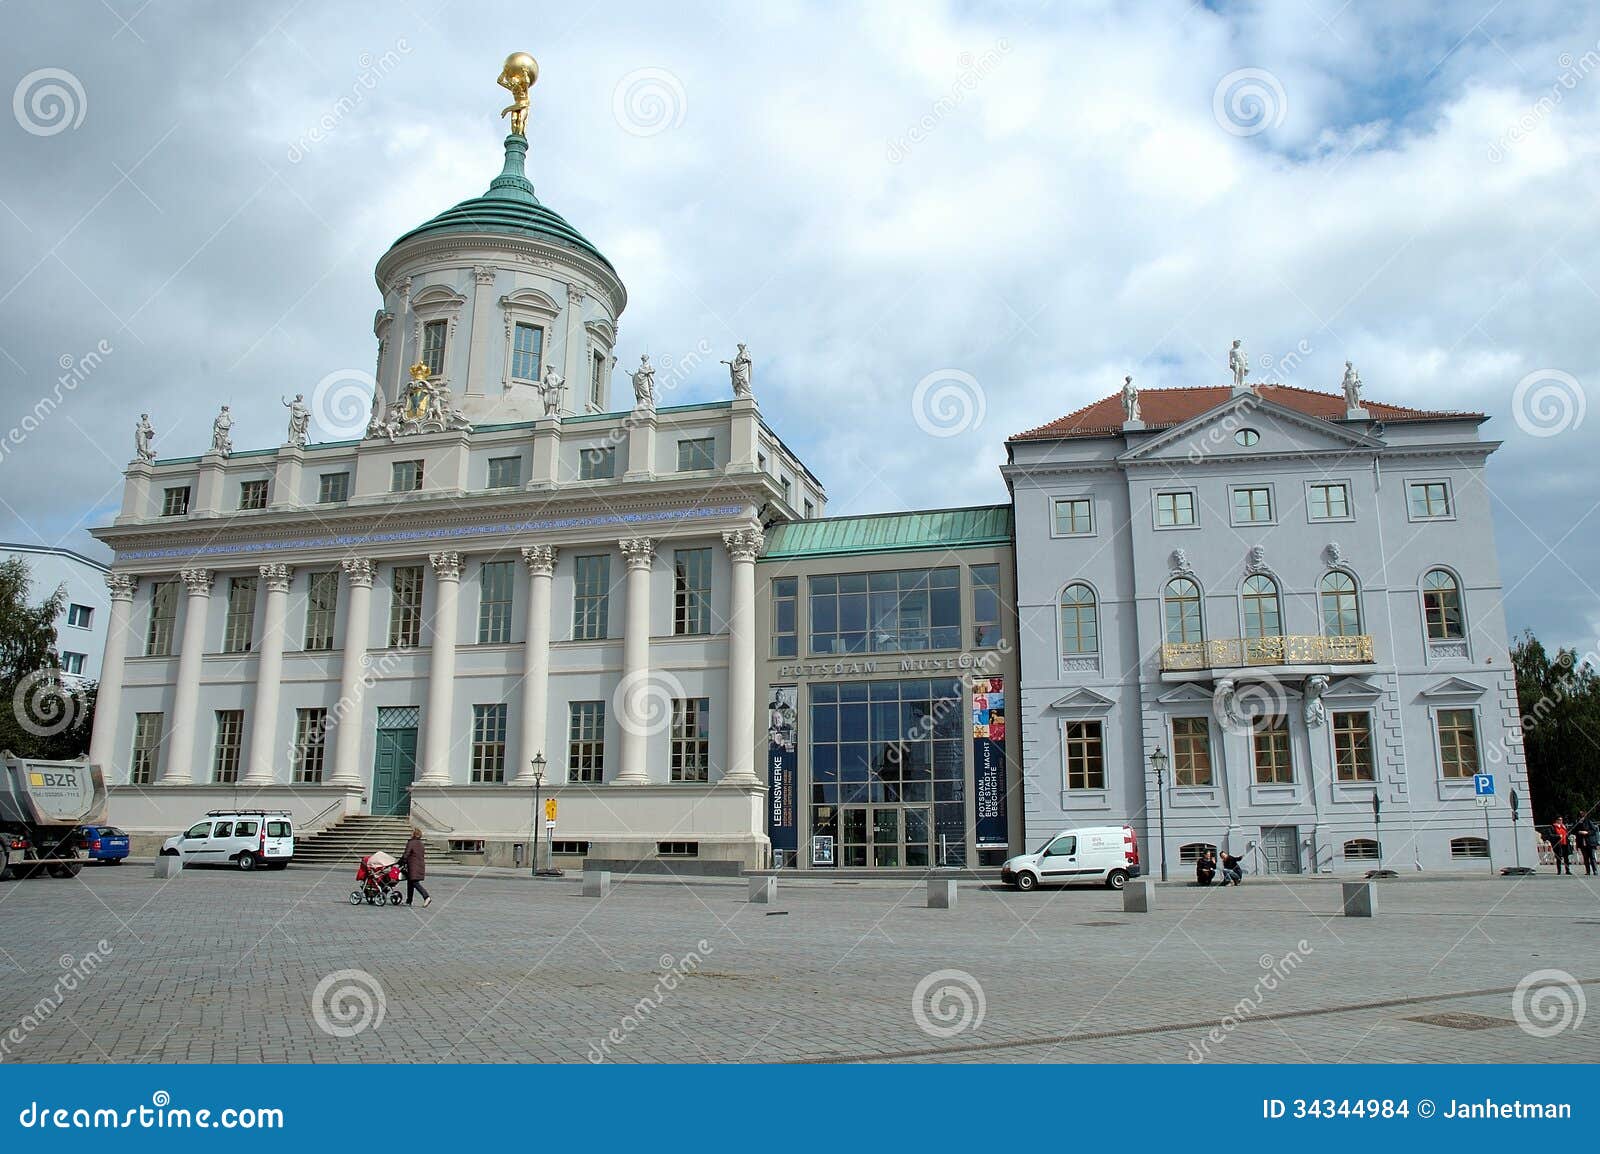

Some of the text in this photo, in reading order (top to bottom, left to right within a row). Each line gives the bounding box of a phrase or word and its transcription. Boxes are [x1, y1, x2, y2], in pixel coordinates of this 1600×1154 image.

[780, 660, 878, 677] POTSDAM
[44, 773, 78, 787] BZR
[1479, 777, 1490, 793] P
[773, 756, 782, 827] LEBENSWERKE
[990, 766, 998, 818] GESCHICHTE
